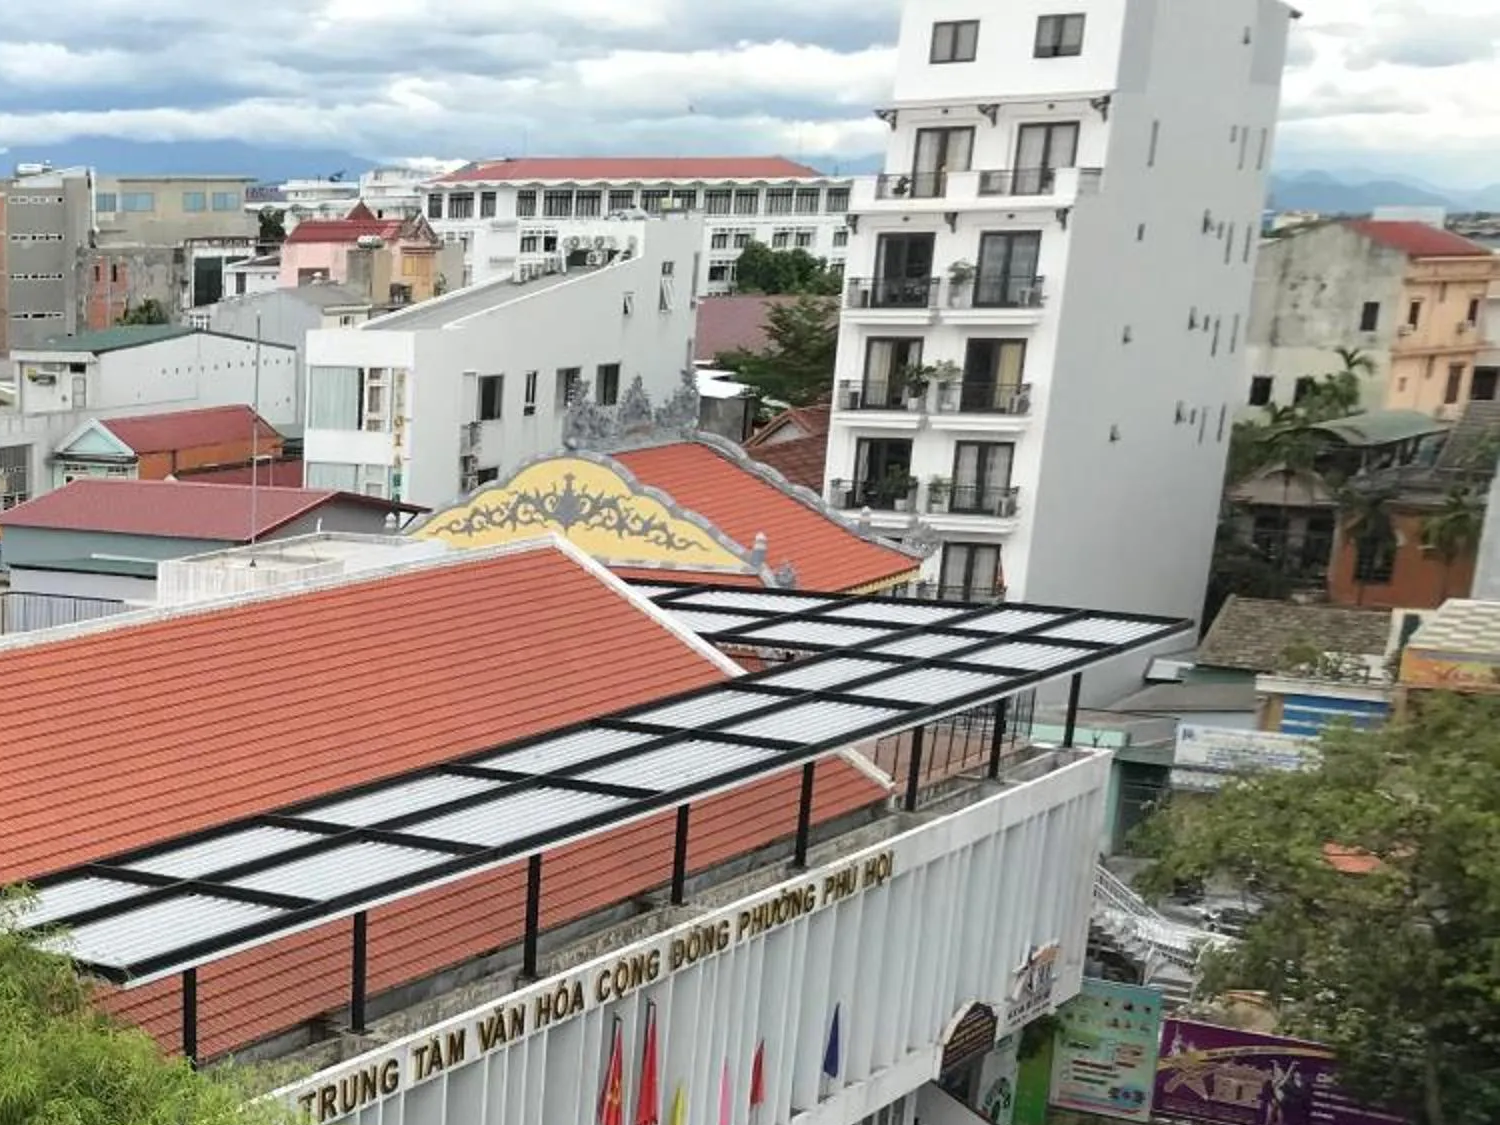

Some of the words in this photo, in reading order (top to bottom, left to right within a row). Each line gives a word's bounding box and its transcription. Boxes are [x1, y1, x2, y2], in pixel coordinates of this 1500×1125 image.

[298, 1059, 399, 1123] TRUNG
[476, 1003, 526, 1055] VĂN
[534, 979, 585, 1029] HÓA
[595, 949, 660, 1001] CỘNG
[736, 884, 816, 941] PHƯỜNG
